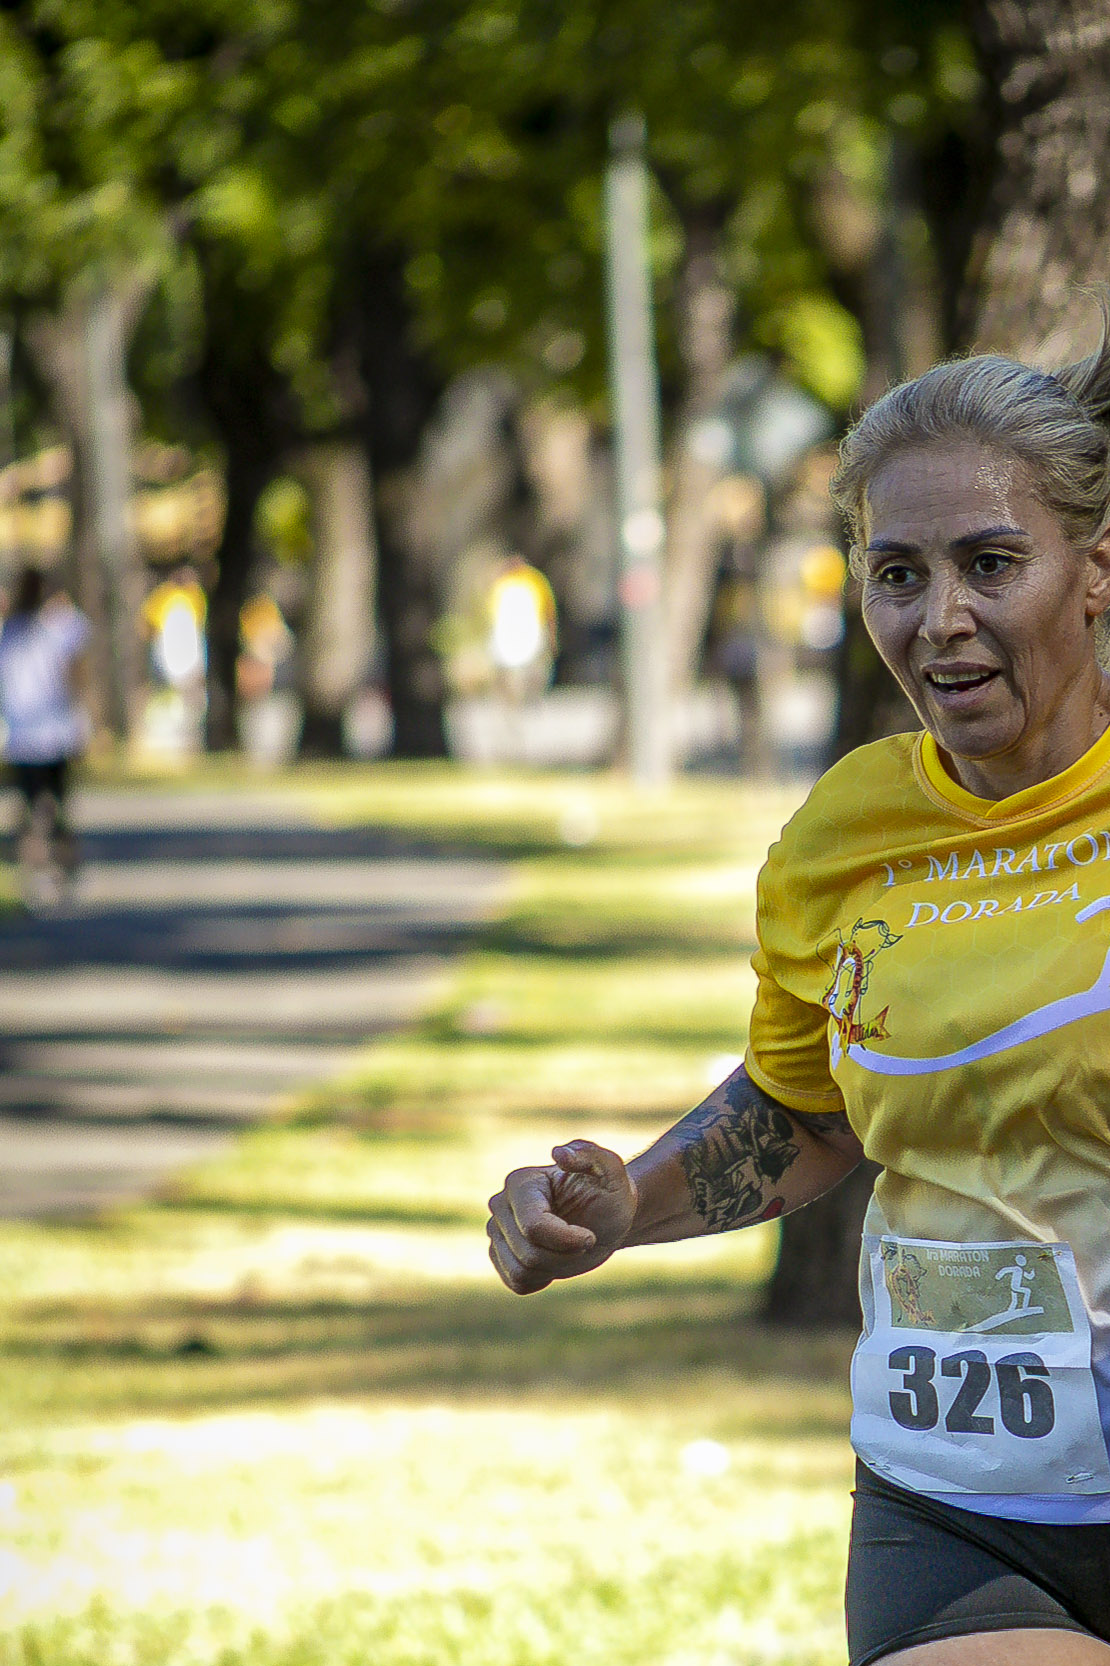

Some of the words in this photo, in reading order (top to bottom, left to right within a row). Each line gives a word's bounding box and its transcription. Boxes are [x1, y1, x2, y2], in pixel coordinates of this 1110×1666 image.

[904, 882, 1081, 928] DORADA
[938, 1264, 981, 1277] DORADA
[888, 1345, 1055, 1438] 326
